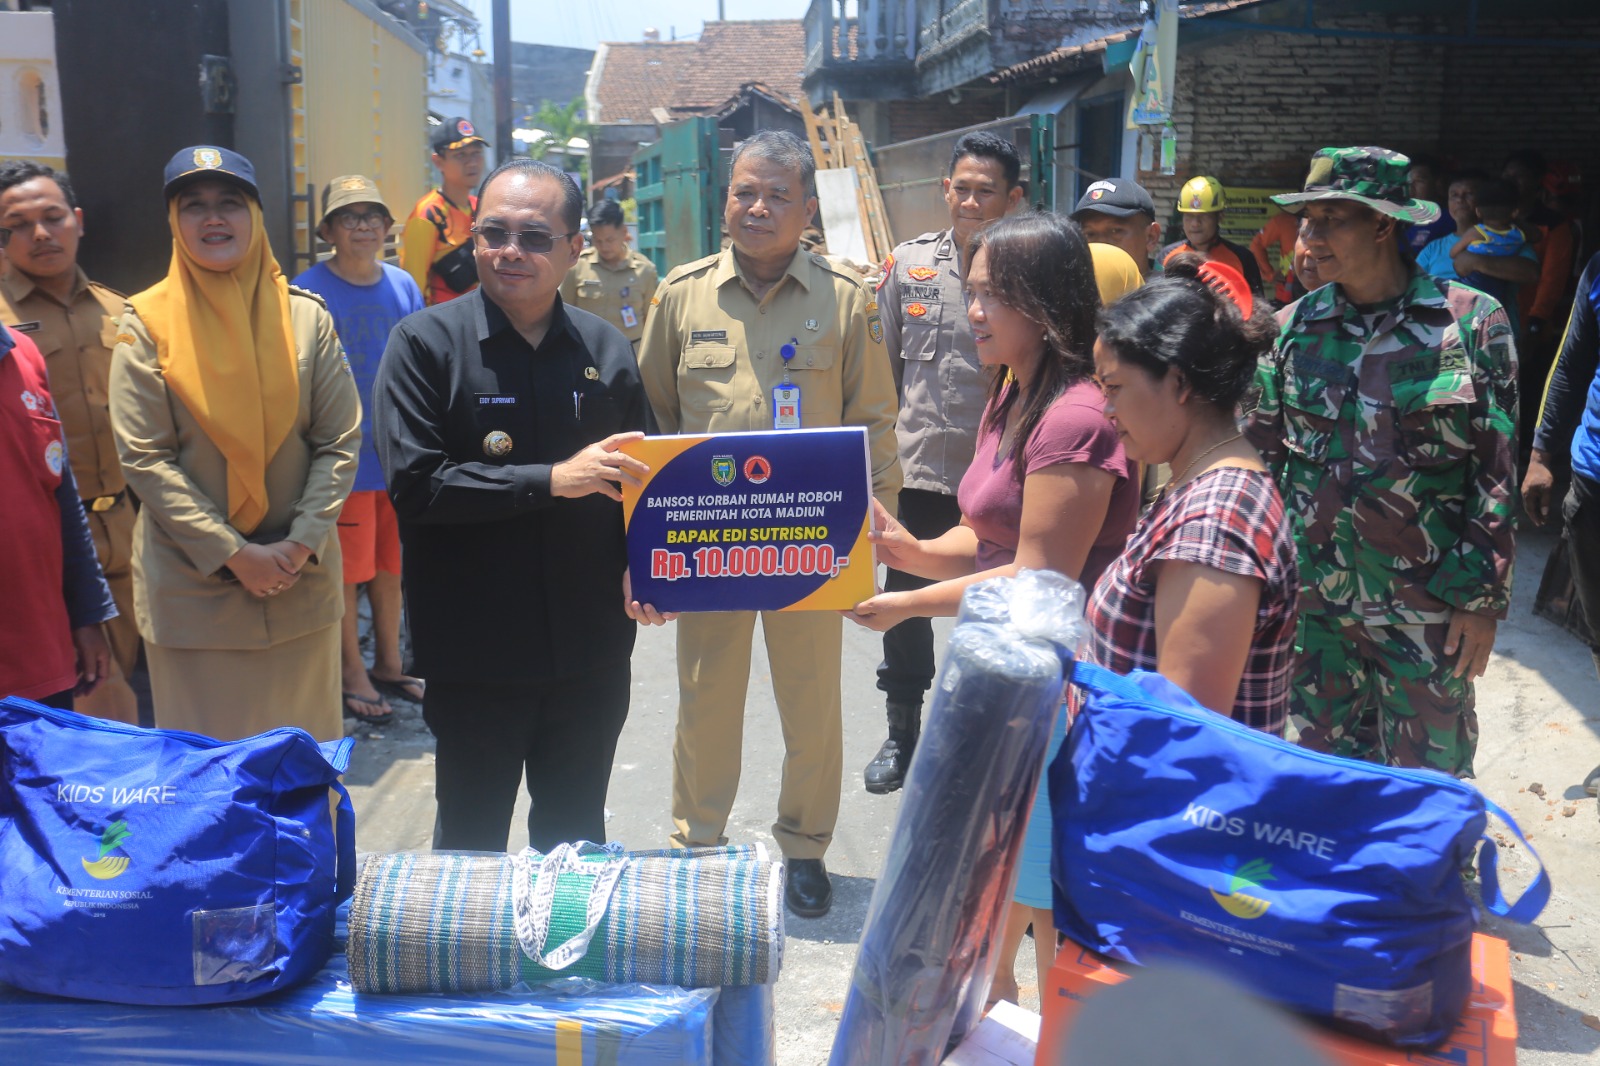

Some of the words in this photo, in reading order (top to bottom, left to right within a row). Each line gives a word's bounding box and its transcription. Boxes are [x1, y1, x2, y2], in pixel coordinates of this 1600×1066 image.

[647, 496, 694, 508] BANSOS
[697, 494, 747, 506] KORBAN
[750, 493, 794, 505] RUMAH
[798, 491, 843, 503] ROBOH
[666, 509, 738, 522] PEMERINTAH
[741, 507, 773, 519] KOTA
[775, 506, 825, 518] MADIUN
[666, 529, 719, 544] BAPAK
[723, 528, 747, 542] EDI
[750, 526, 828, 541] SUTRISNO
[651, 548, 691, 581] Rp.
[693, 544, 849, 578] 10.000.000,-
[57, 784, 106, 804] KIDS
[112, 786, 177, 805] WARE
[1182, 802, 1246, 836] KIDS
[1253, 821, 1338, 861] WARE
[56, 886, 118, 899] KEMENTERIAN
[119, 890, 153, 899] SOSIAL
[63, 900, 96, 909] REPUBLIK
